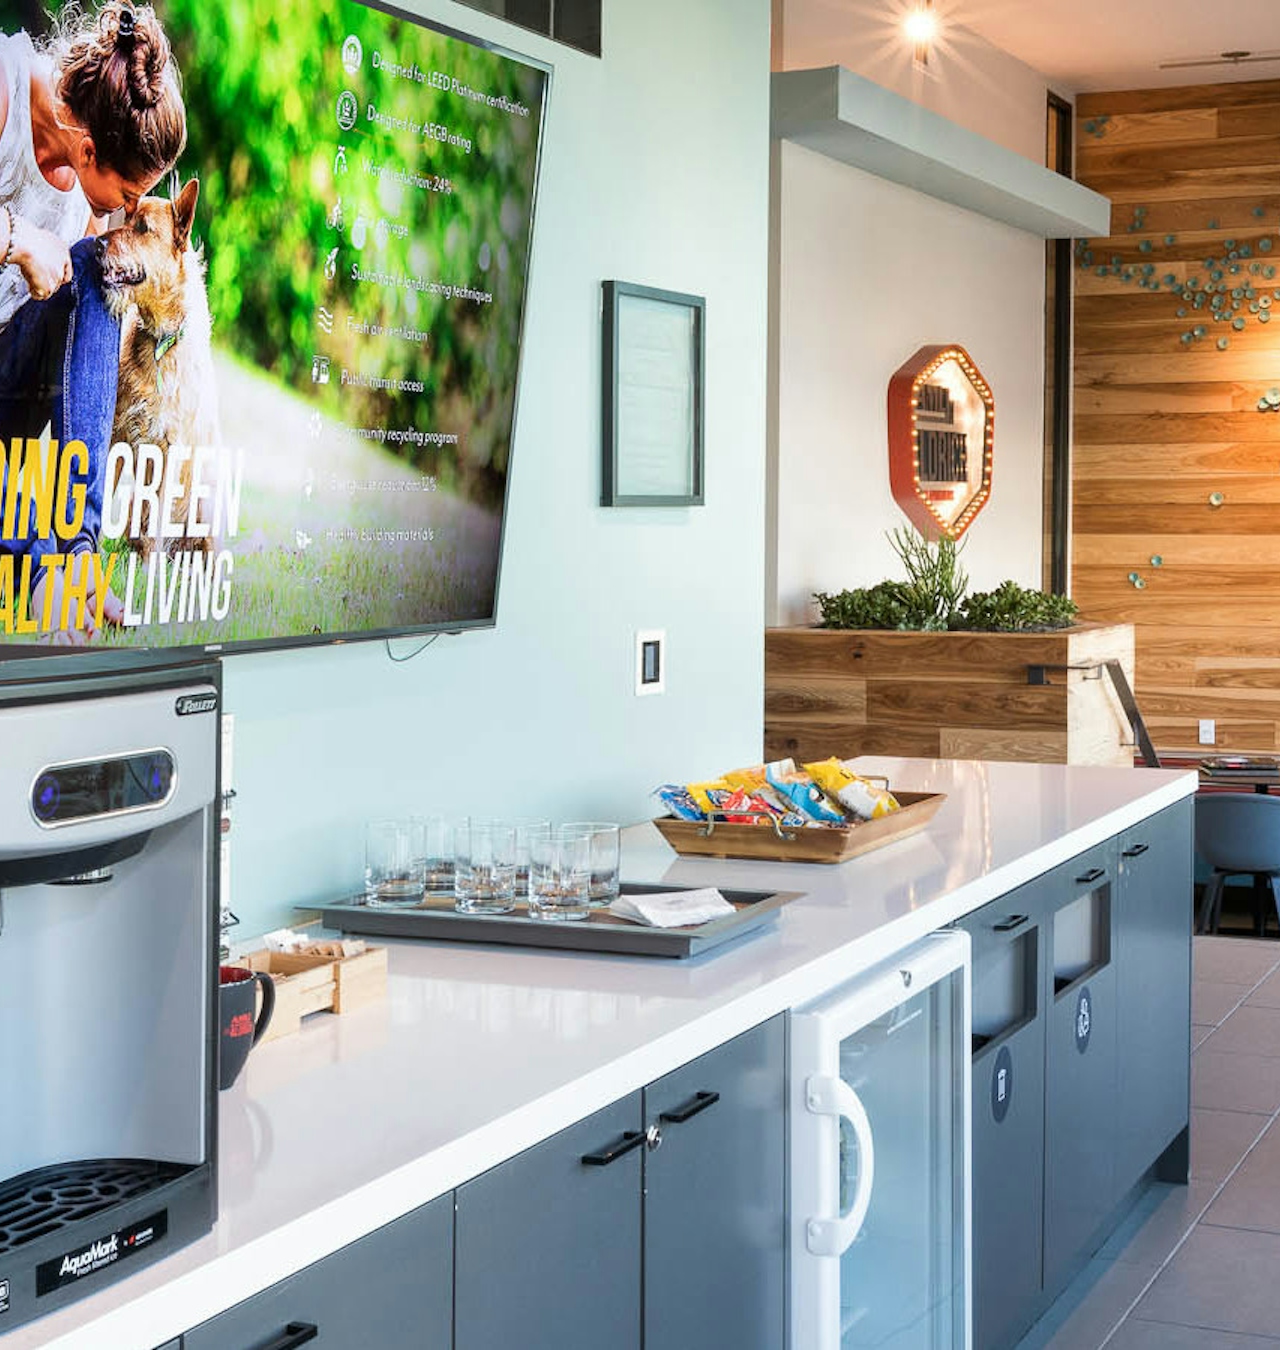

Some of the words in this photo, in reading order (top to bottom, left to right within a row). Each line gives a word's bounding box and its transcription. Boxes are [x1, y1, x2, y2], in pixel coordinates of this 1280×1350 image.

[372, 50, 413, 79] Designed
[413, 68, 426, 84] for
[427, 71, 450, 91] LEED
[450, 77, 487, 104] Platinum
[486, 94, 530, 117] certification
[367, 103, 408, 132] Designed
[408, 119, 422, 135] for
[423, 122, 449, 143] AEGB
[448, 132, 472, 154] rating
[433, 174, 453, 195] 24%
[451, 284, 493, 305] techniques
[346, 315, 369, 334] Fresh
[398, 381, 424, 393] access
[387, 427, 424, 446] recycling
[424, 433, 458, 447] program
[100, 441, 244, 539] GREEN
[122, 550, 233, 627] LIVING
[59, 1234, 119, 1277] AquaMark
